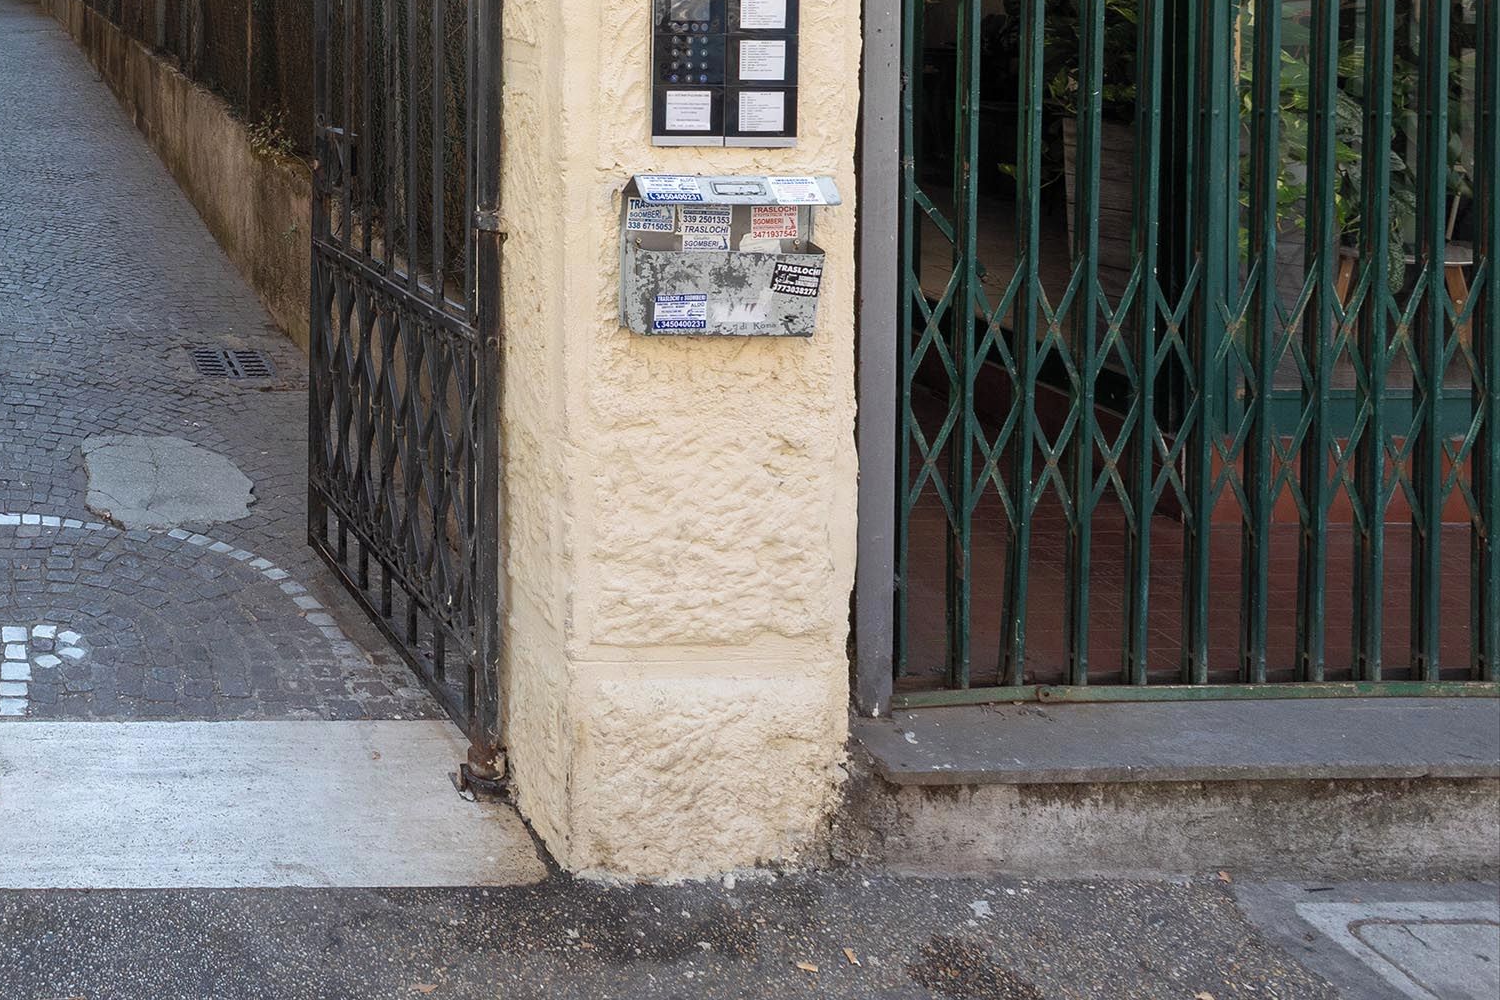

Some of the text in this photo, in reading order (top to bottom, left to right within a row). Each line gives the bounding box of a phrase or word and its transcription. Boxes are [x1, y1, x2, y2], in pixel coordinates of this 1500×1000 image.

[655, 193, 701, 201] 3450400231
[629, 209, 661, 219] SGOMBERI
[683, 215, 697, 223] 339
[698, 215, 730, 224] 2501353
[753, 217, 784, 225] SGOMBERI
[628, 221, 641, 229] 338
[642, 222, 673, 231] 6715053
[684, 225, 729, 234] TRASLOCHI
[753, 230, 797, 239] 3471937542
[777, 264, 821, 276] TRASLOCHI
[661, 320, 705, 329] 3450400231
